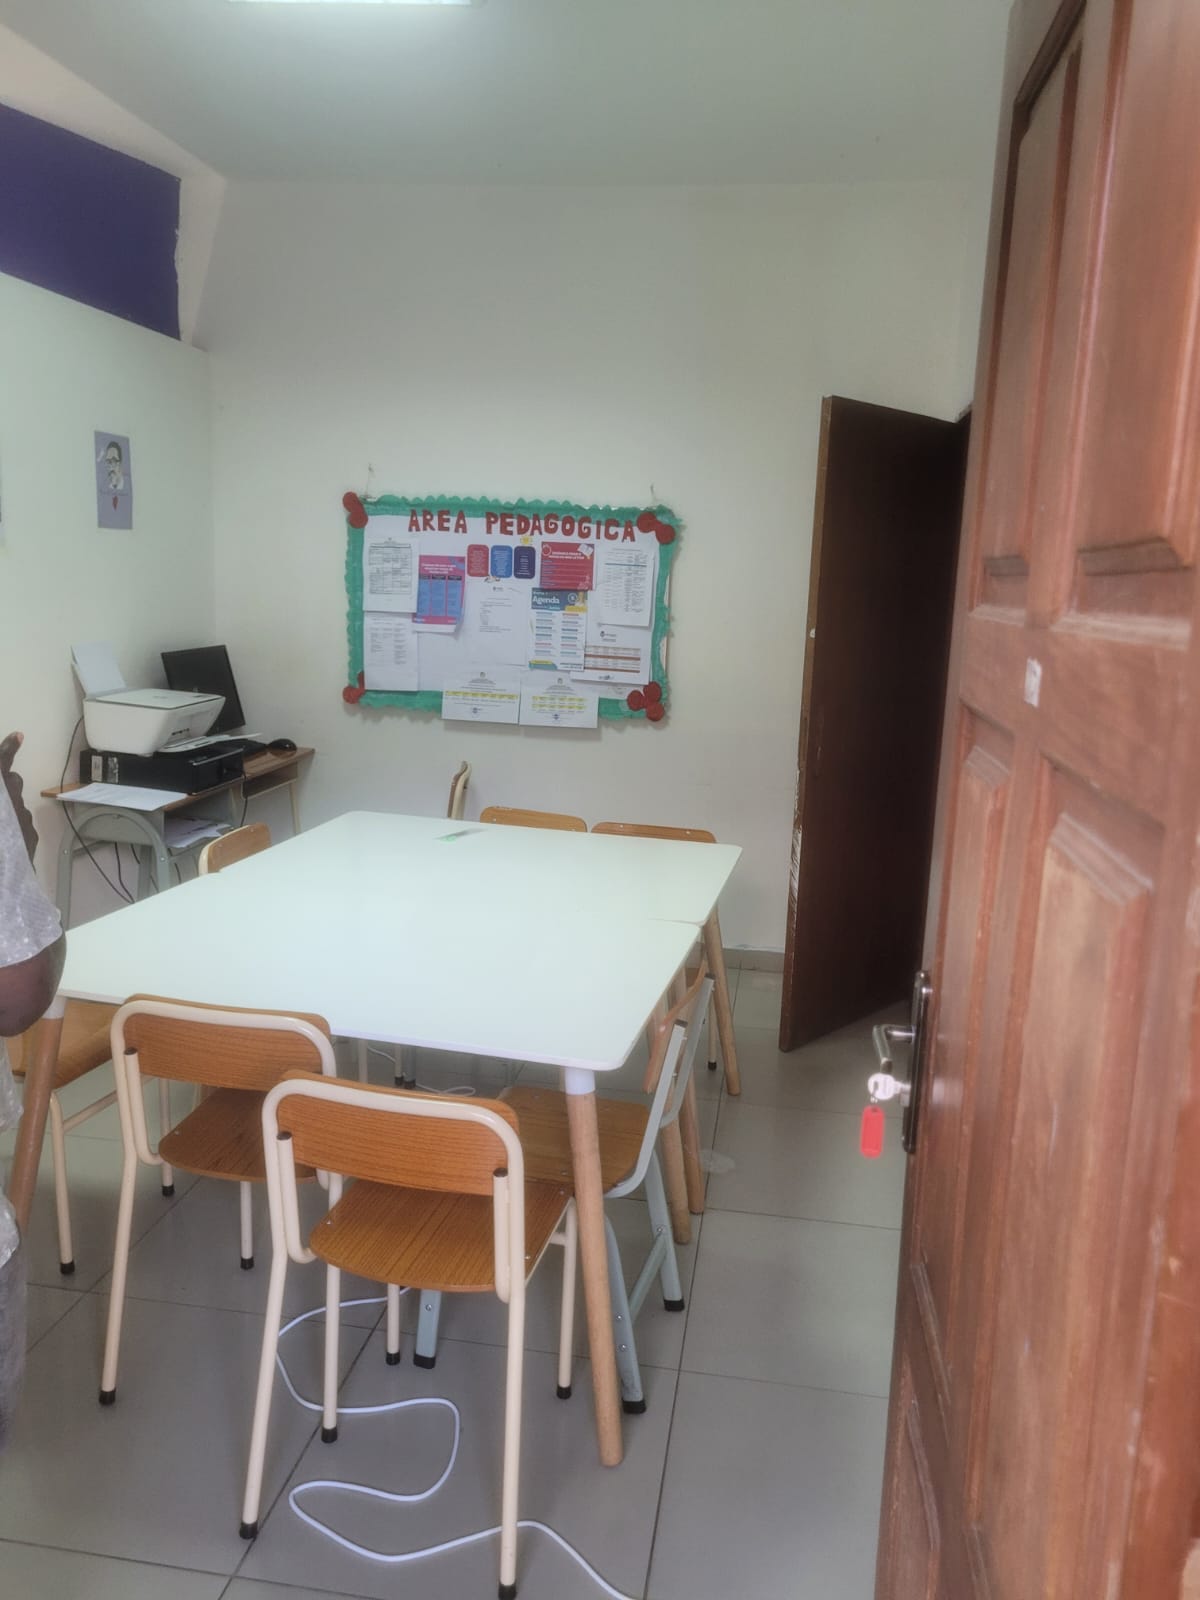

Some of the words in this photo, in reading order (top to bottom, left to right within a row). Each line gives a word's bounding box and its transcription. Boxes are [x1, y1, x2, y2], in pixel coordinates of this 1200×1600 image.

[408, 509, 468, 534] AREA
[485, 511, 636, 543] PEDAGOGICA
[532, 595, 560, 605] Agenda
